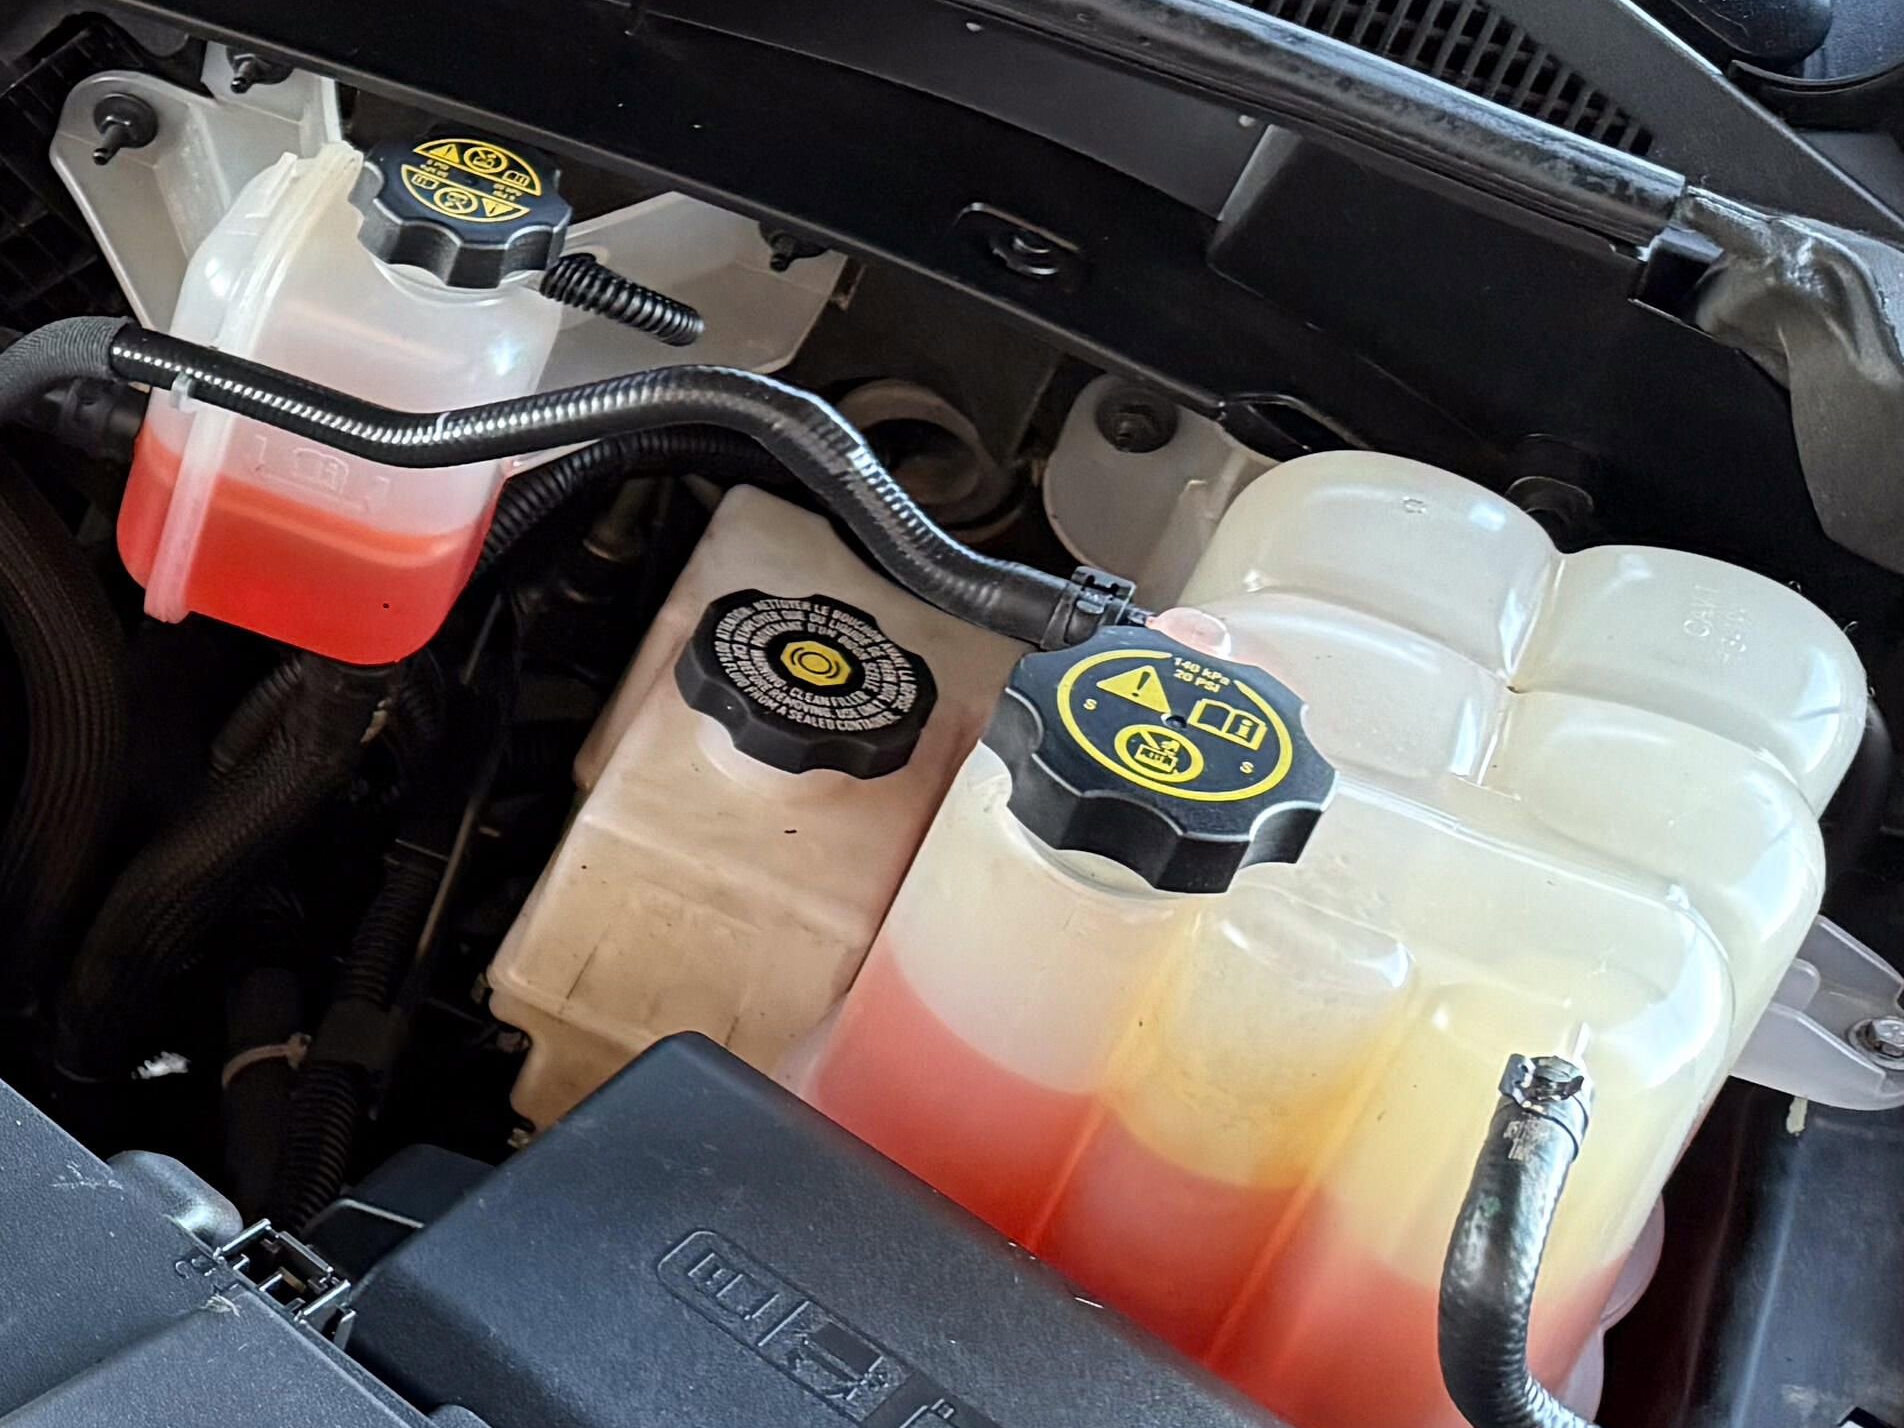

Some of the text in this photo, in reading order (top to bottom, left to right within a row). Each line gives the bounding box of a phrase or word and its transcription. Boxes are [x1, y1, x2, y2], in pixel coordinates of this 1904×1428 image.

[1174, 657, 1230, 686] 140 kPa
[1174, 669, 1221, 693] 20 PSI
